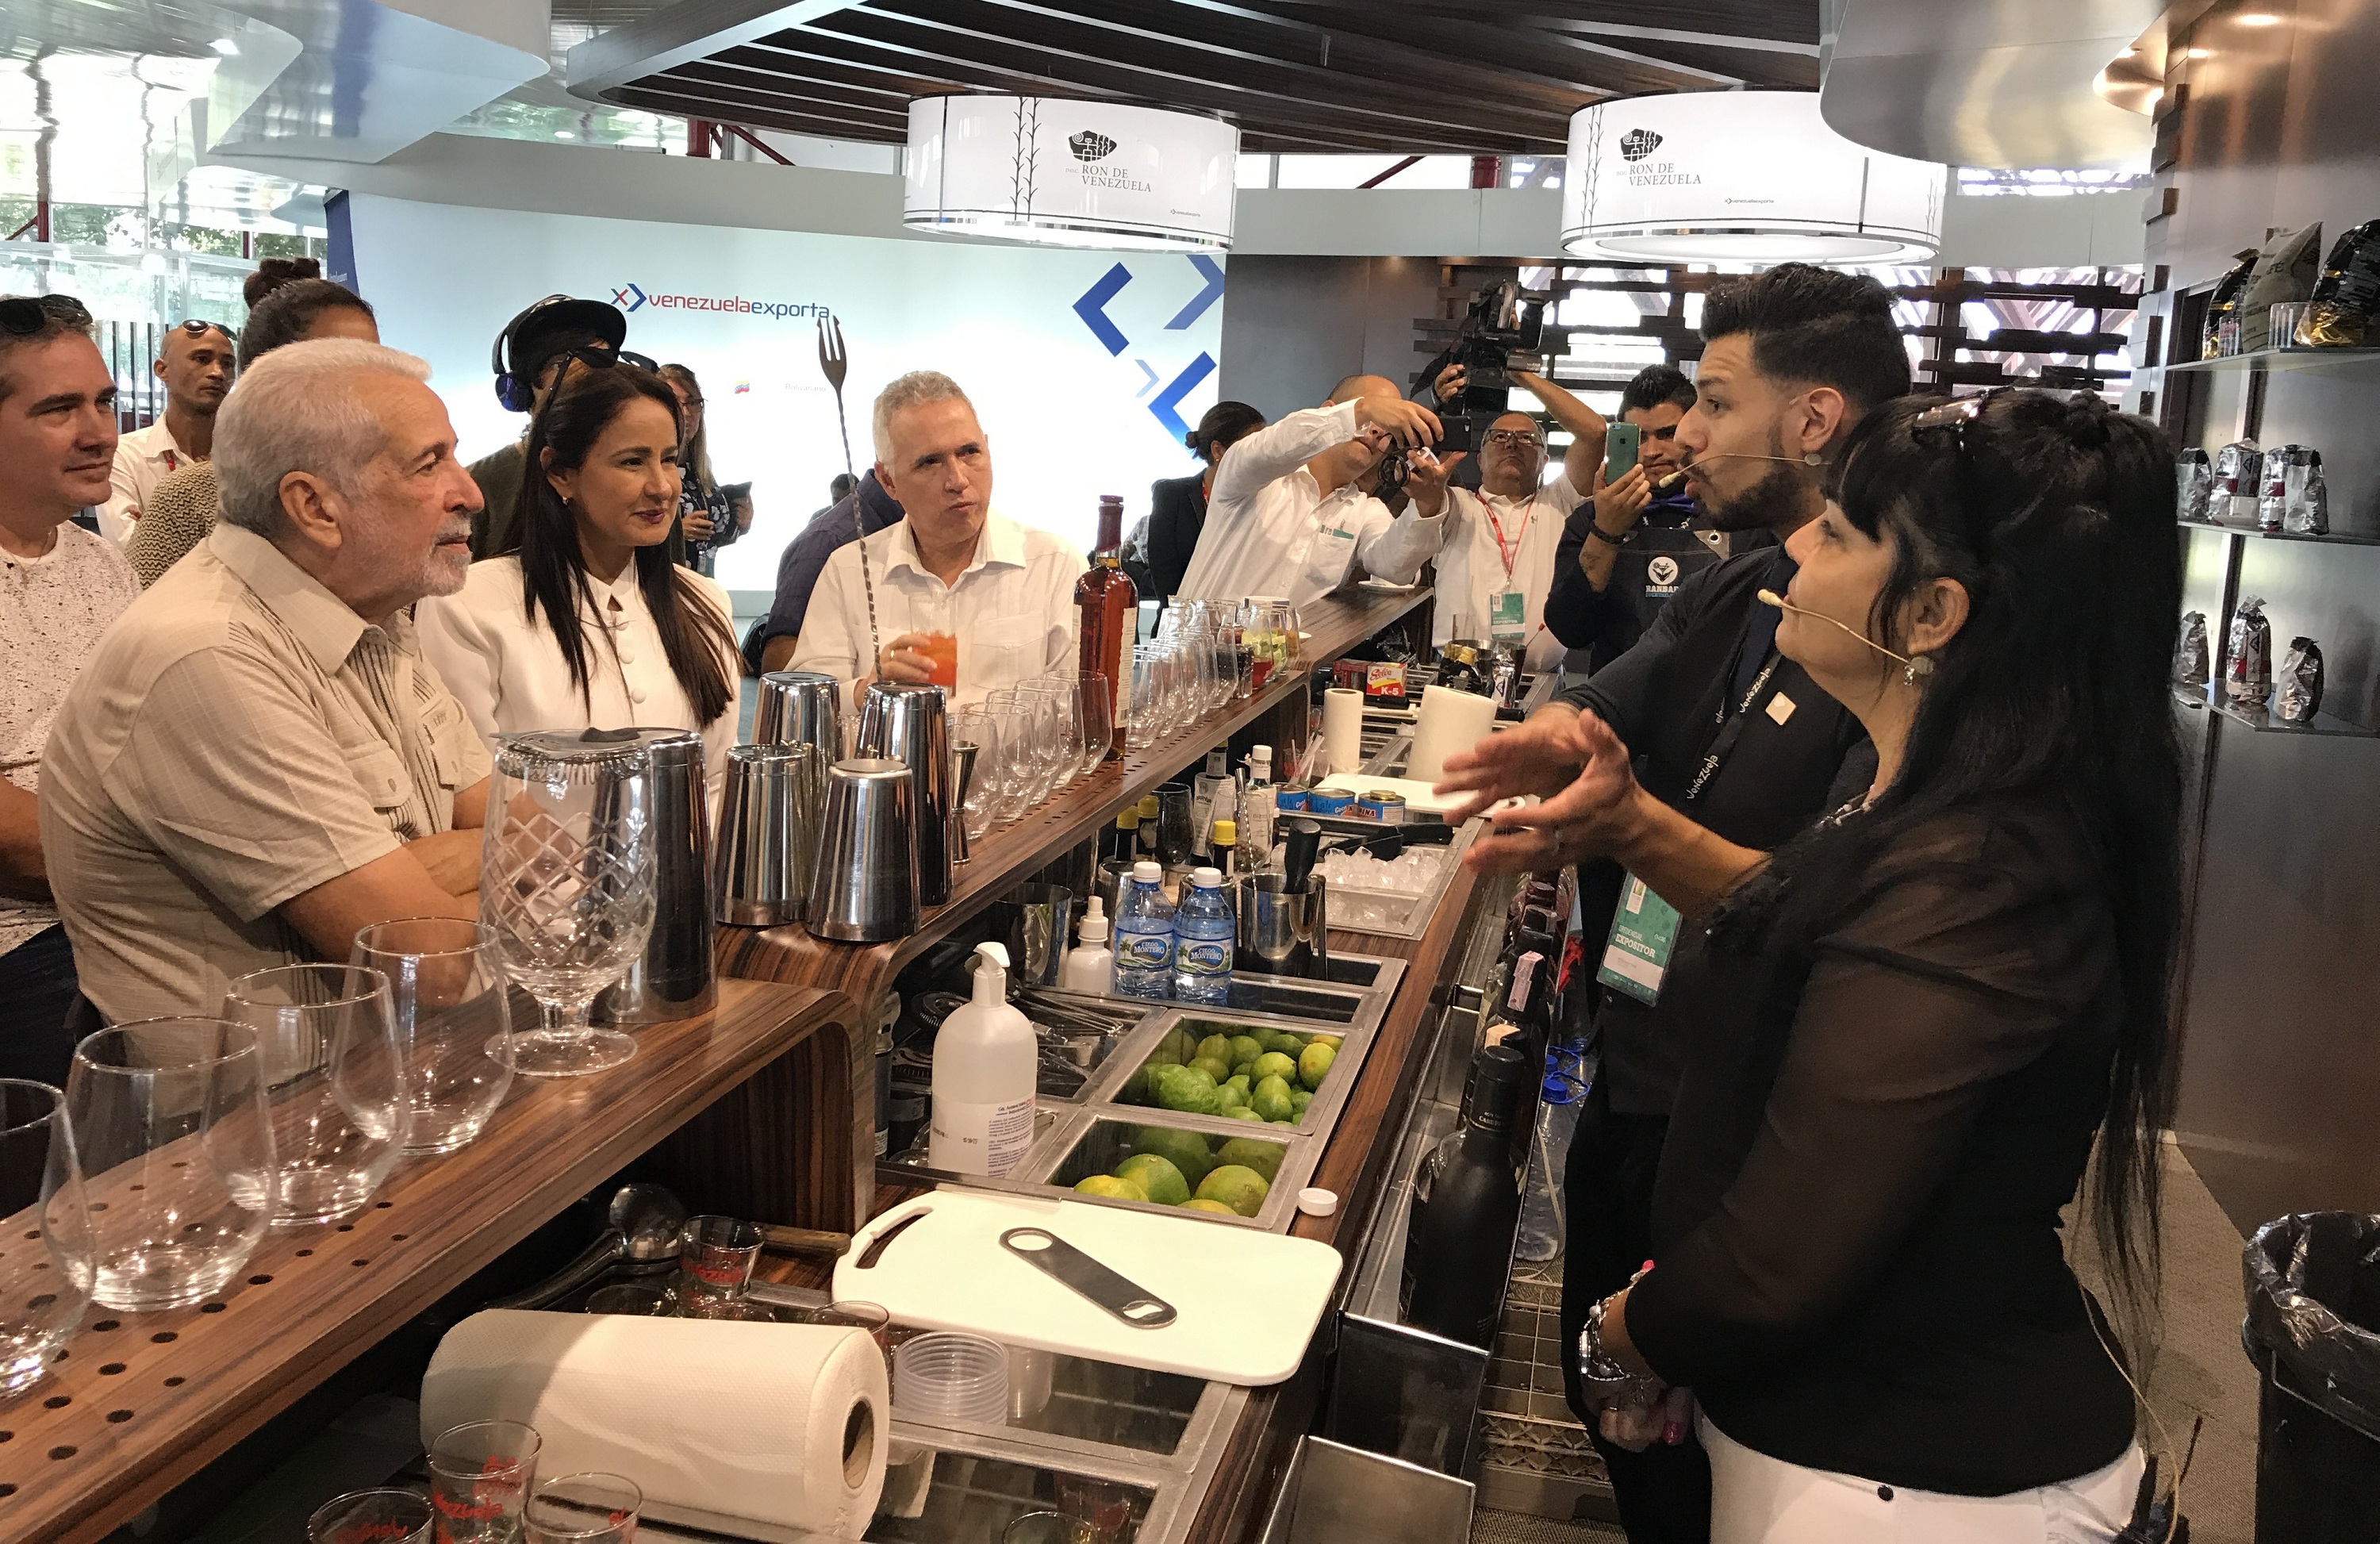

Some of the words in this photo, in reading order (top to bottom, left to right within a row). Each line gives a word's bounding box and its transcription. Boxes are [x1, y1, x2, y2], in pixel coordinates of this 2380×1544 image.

[1082, 164, 1110, 178] RON
[1113, 167, 1129, 179] DE
[1629, 163, 1654, 174] RON
[1657, 163, 1675, 173] DE
[1082, 175, 1152, 193] VENEZUELA
[1629, 174, 1702, 186] VENEZUELA
[649, 294, 830, 320] venezuelaexporta
[1380, 686, 1399, 696] K-5
[1134, 946, 1165, 954] MONTERO
[1615, 933, 1656, 958] EXPOSITOR
[1190, 952, 1223, 961] MONTERO
